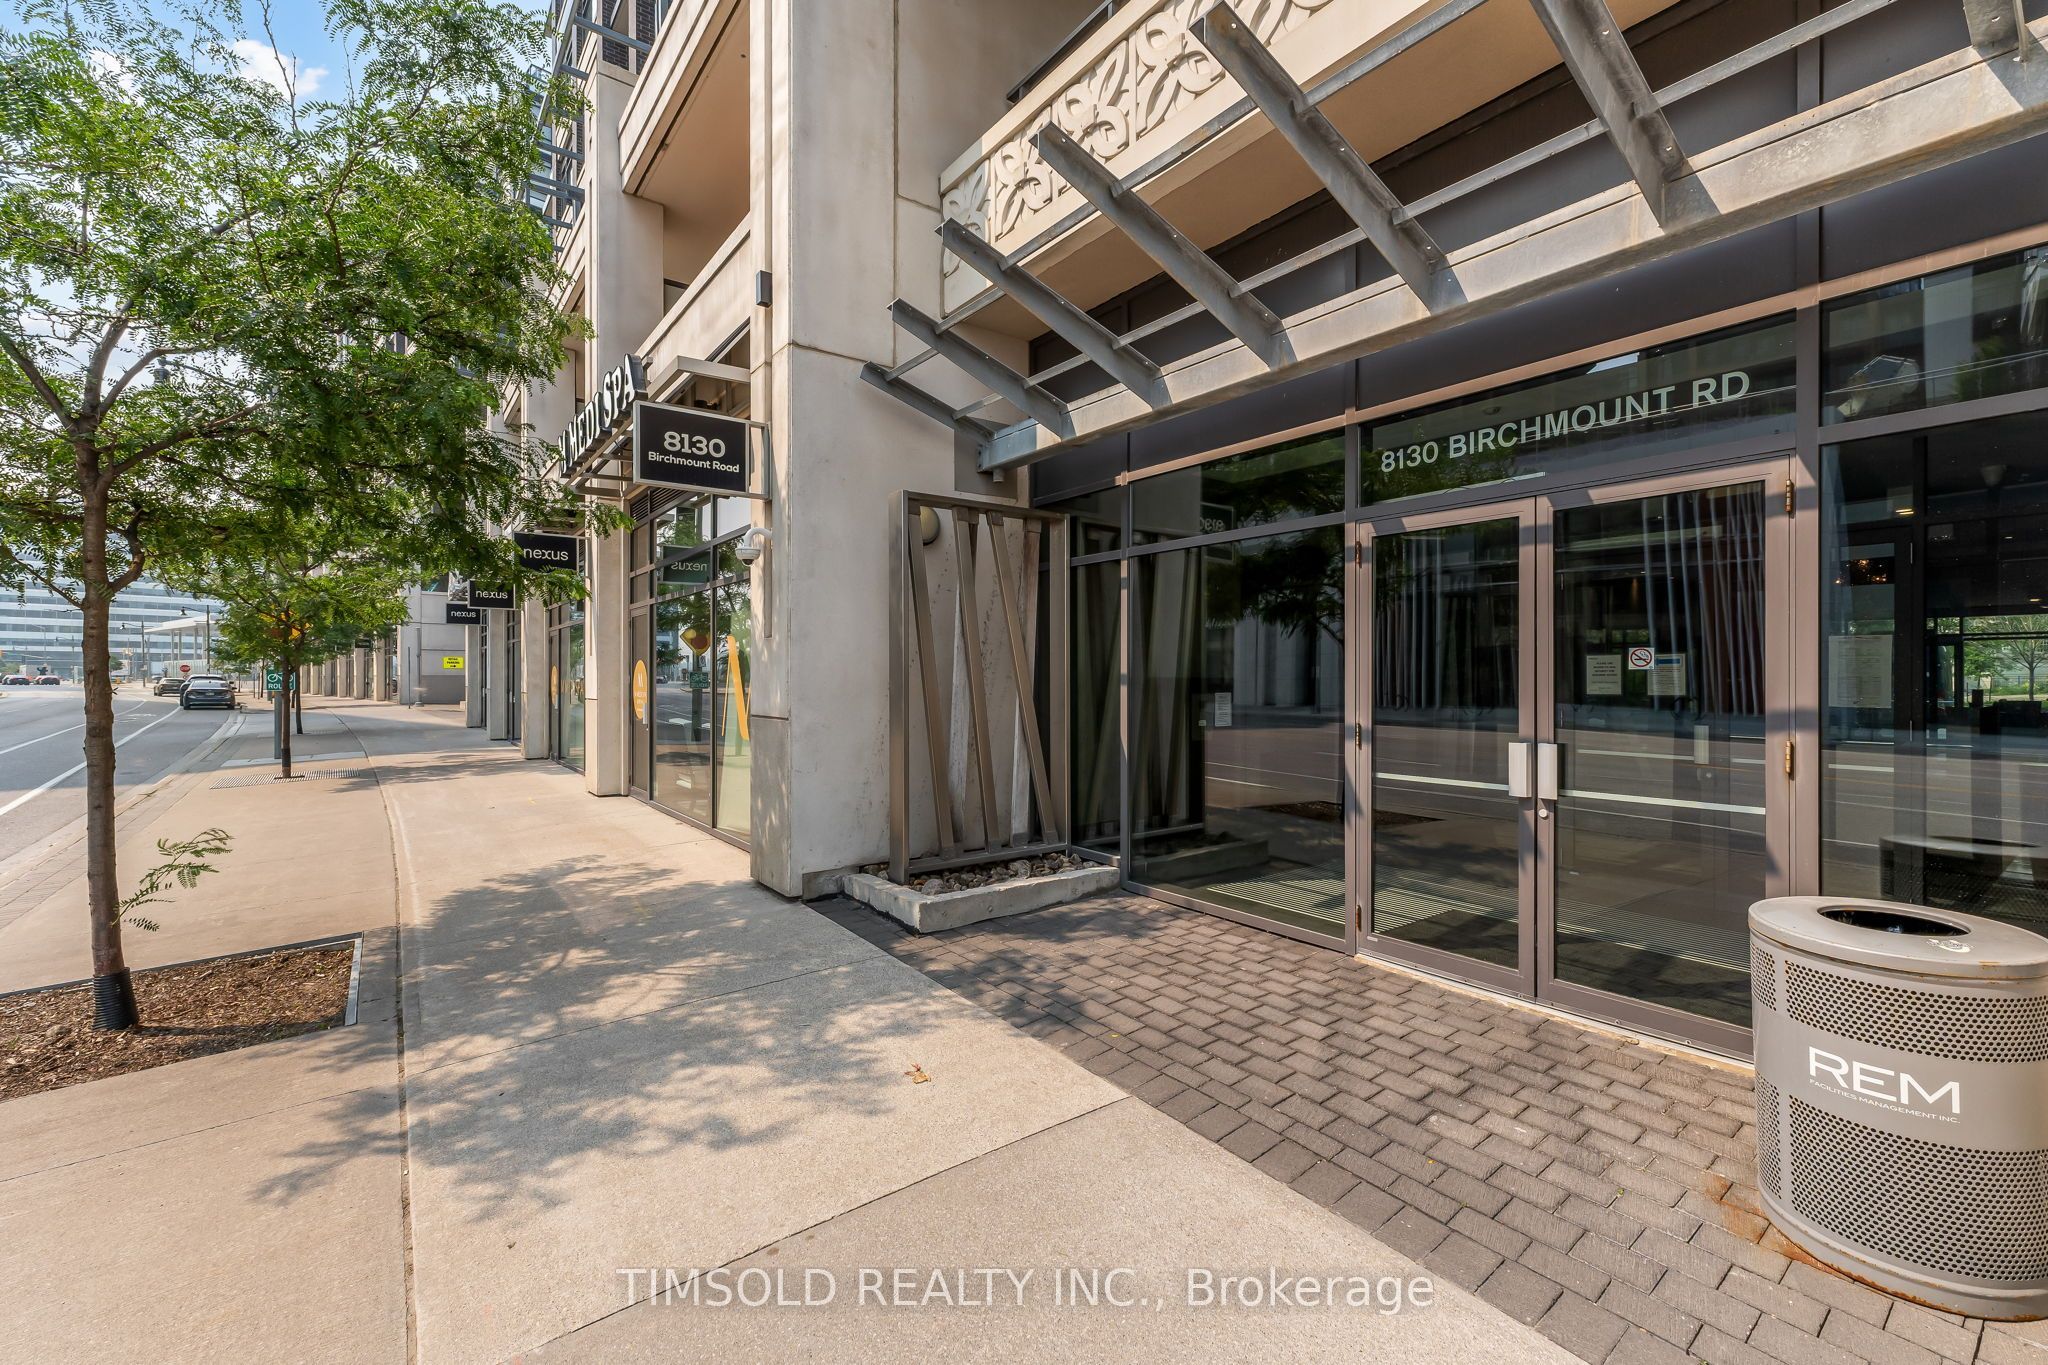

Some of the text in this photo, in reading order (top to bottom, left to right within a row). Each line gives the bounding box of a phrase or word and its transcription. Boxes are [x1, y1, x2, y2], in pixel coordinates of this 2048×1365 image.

[567, 392, 601, 467] MEDI
[603, 353, 635, 428] SPA
[1381, 371, 1750, 473] 8130 BIRCHMOUNT RD
[663, 431, 726, 458] 8130
[648, 451, 740, 473] Birchmount Road
[523, 548, 569, 561] nexus
[475, 590, 508, 599] nexus
[451, 610, 477, 618] nexus
[1808, 1046, 1961, 1114] REM
[1809, 1078, 1961, 1124] FACILITIES MANAGEMENT INC.
